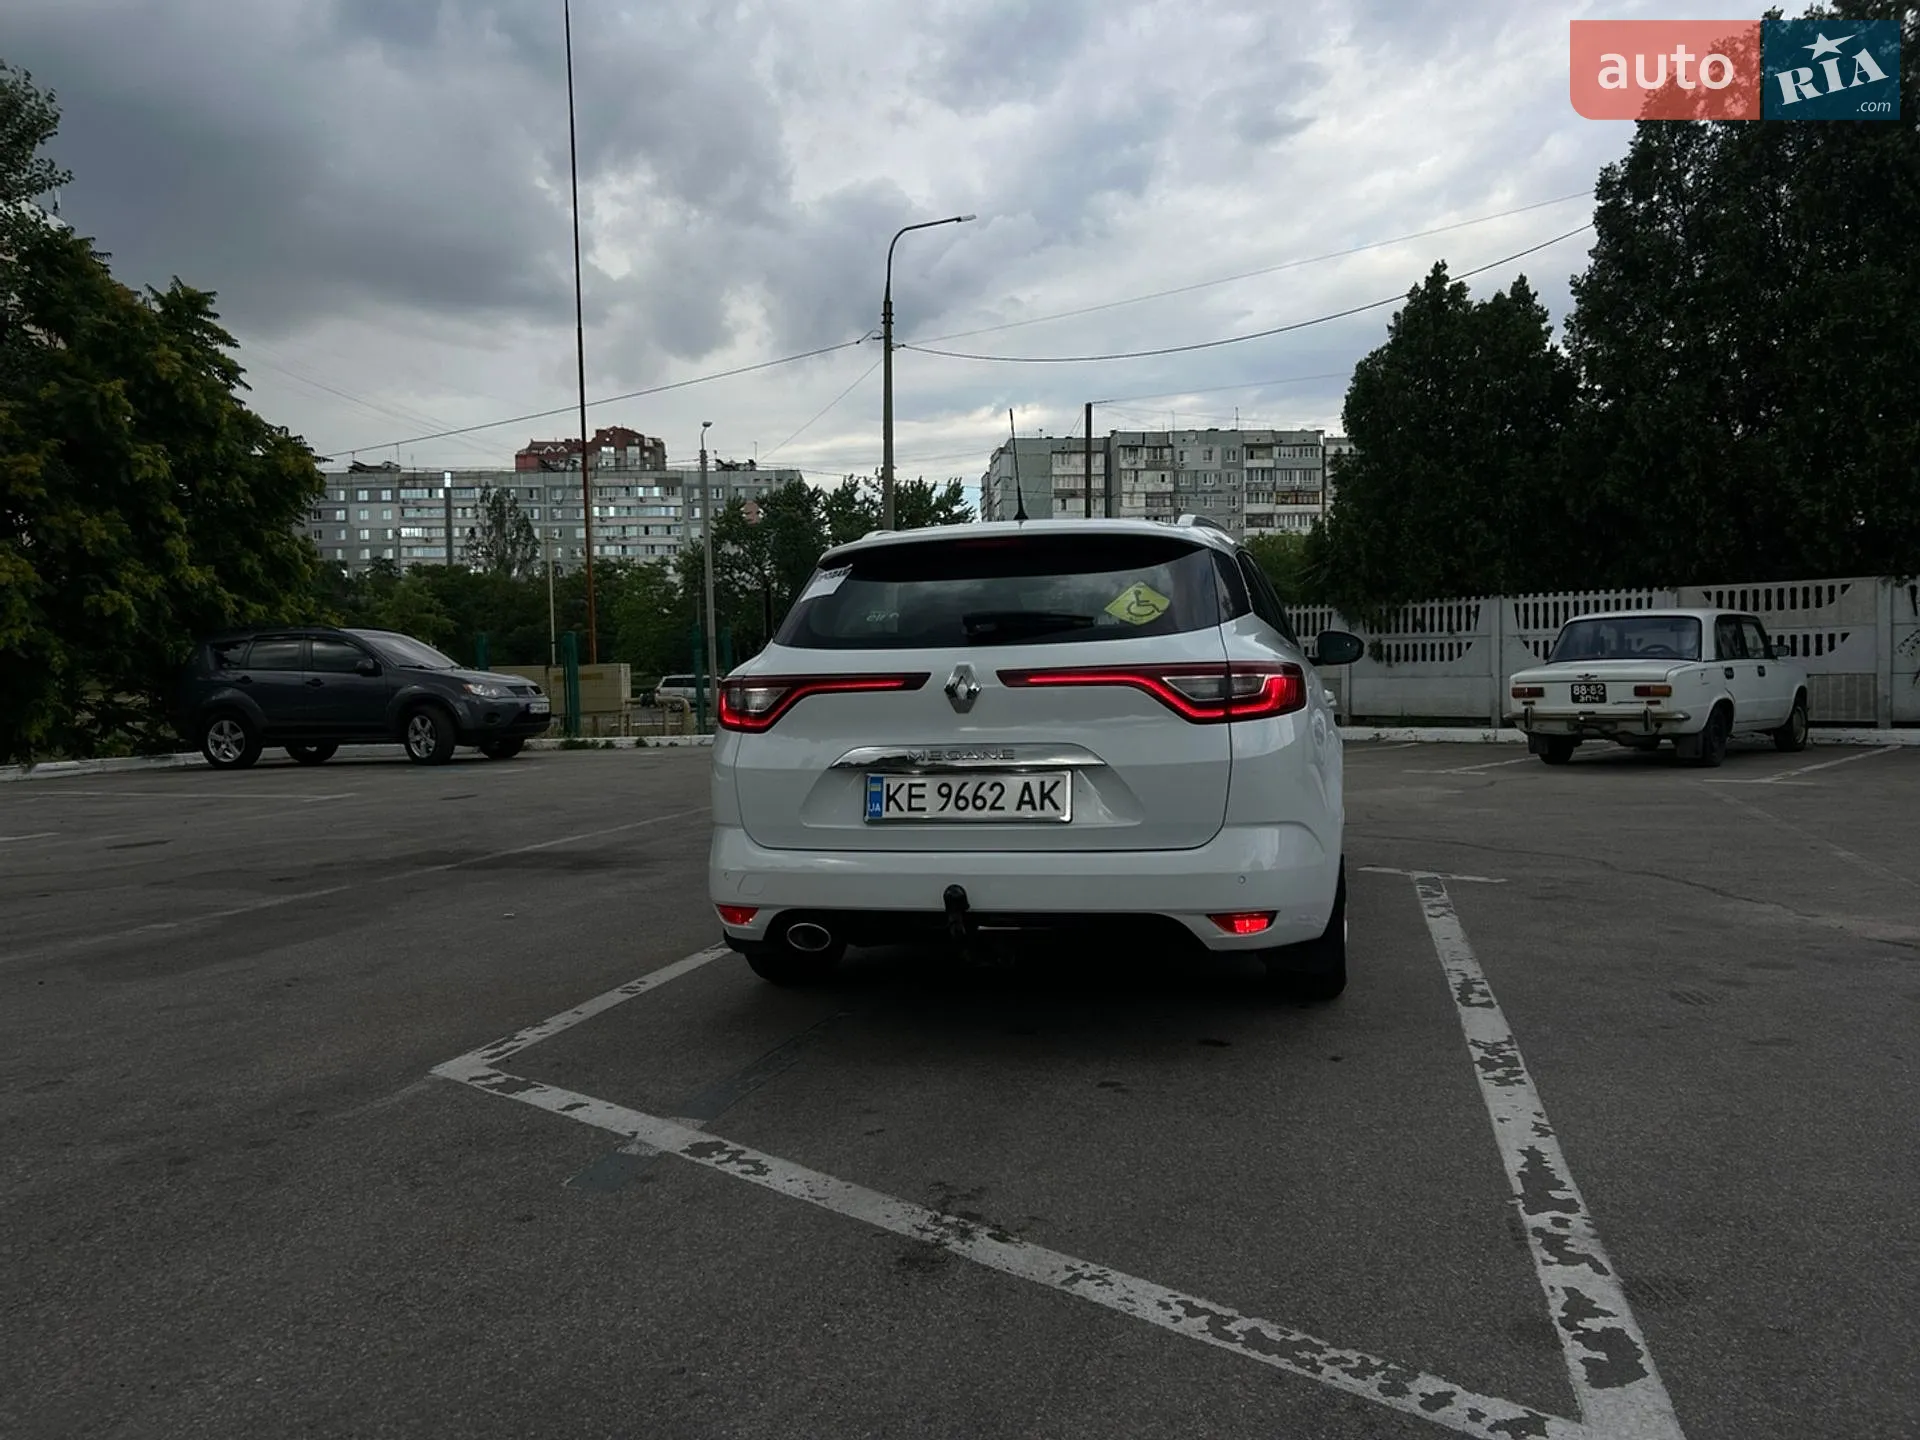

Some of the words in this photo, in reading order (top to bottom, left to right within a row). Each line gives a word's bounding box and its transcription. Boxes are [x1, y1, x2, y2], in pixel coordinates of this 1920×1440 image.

[906, 749, 1016, 761] MEGANE
[885, 782, 927, 812] KE
[937, 781, 1006, 812] 9662
[1015, 780, 1062, 811] AK
